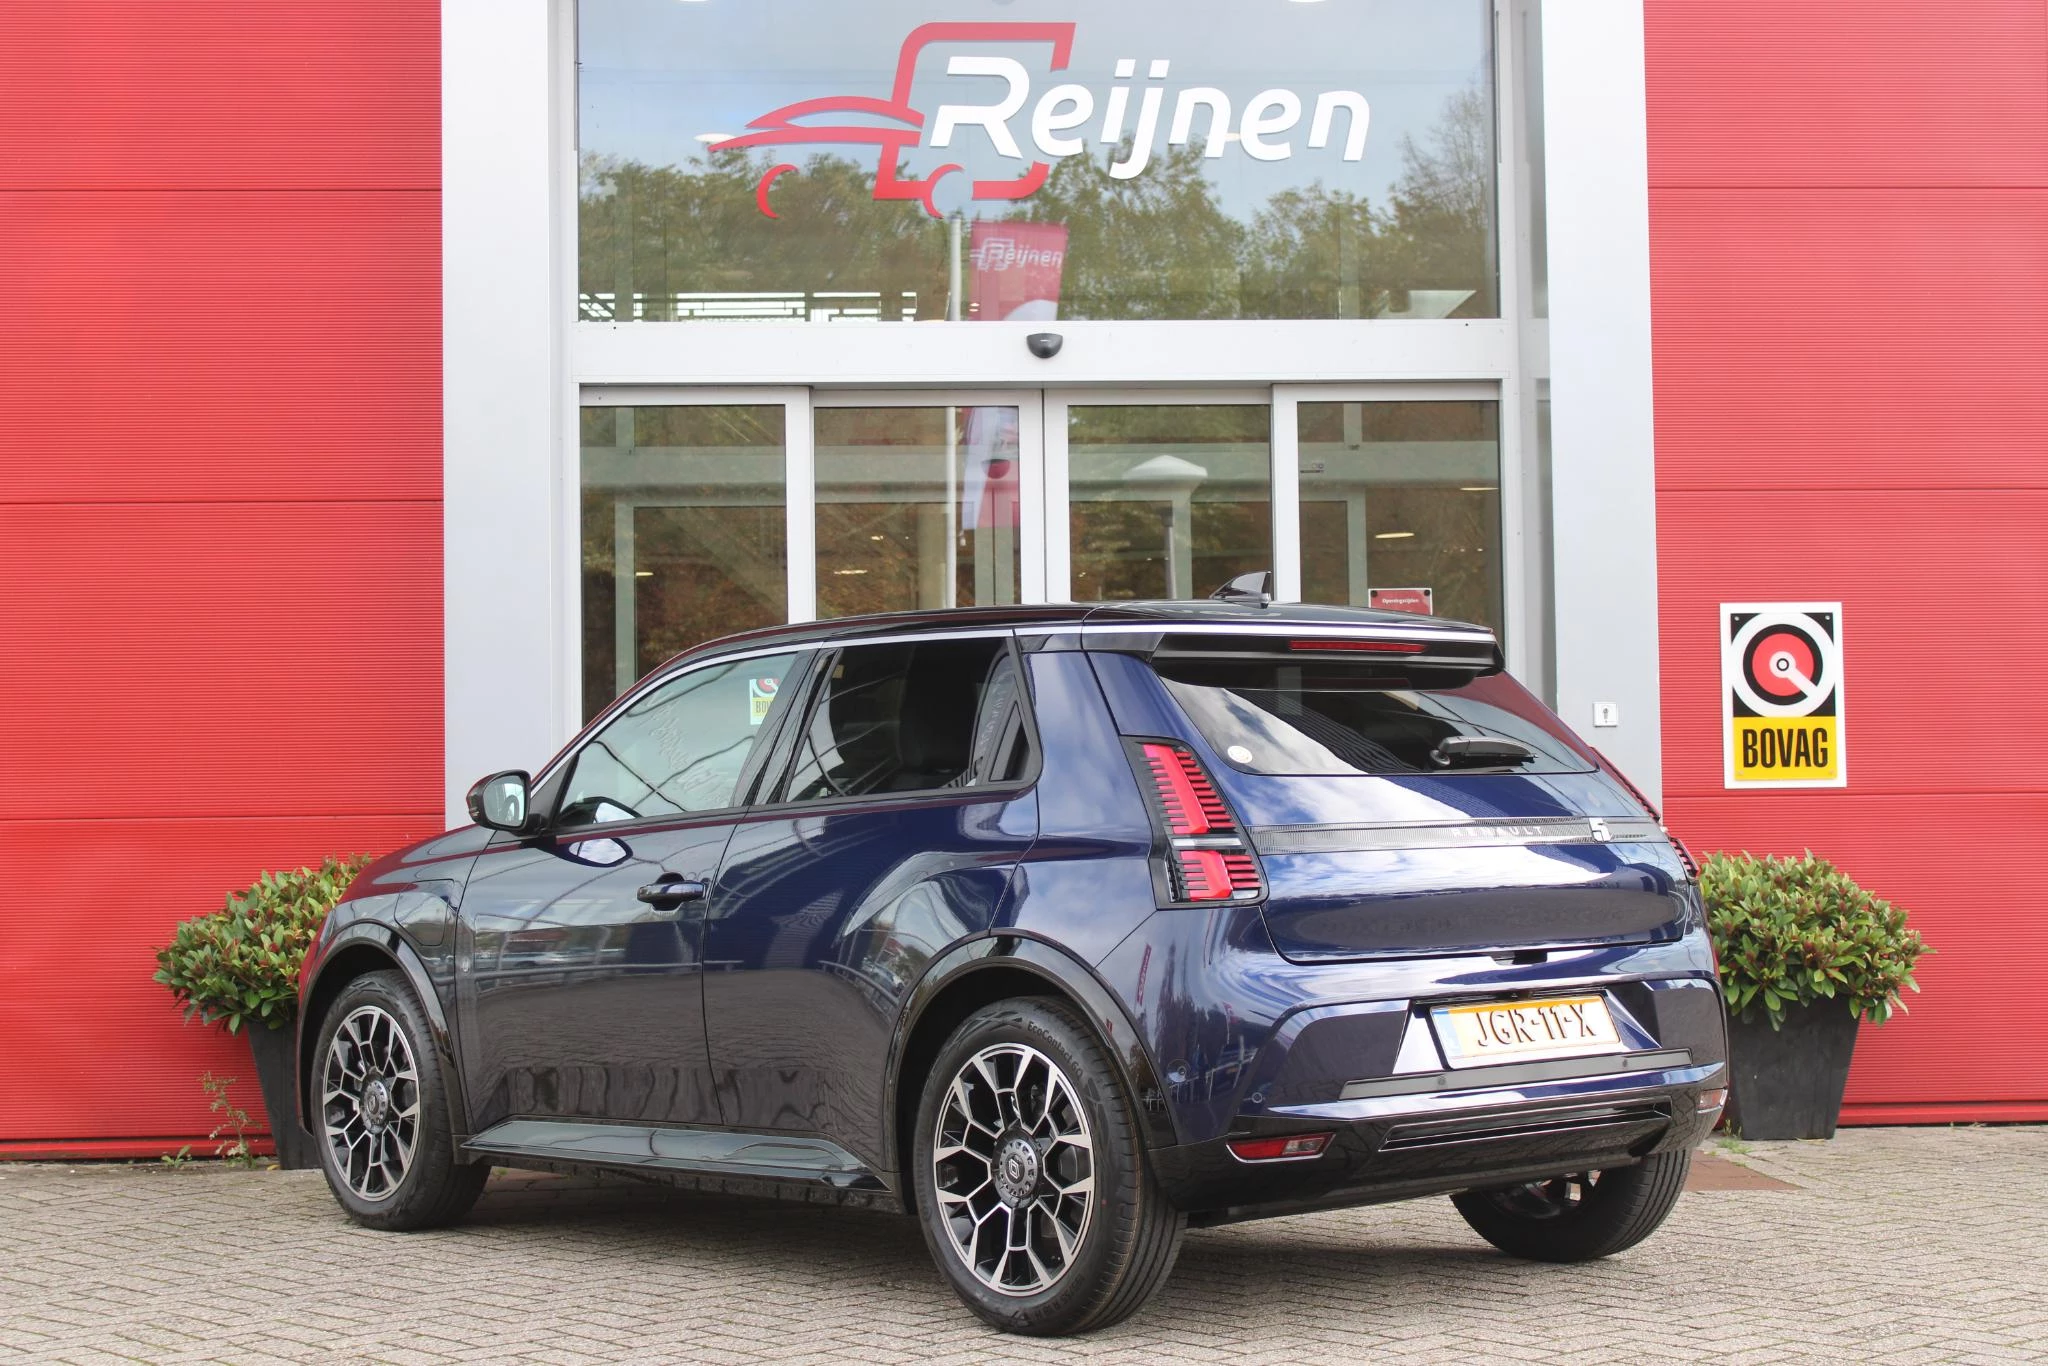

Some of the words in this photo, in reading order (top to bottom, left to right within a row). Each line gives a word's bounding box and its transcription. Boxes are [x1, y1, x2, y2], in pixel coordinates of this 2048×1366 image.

[929, 56, 1370, 180] Reijnen
[988, 242, 1064, 269] Reijnen
[1742, 727, 1829, 769] BOVAG
[1027, 1021, 1073, 1064] EcoContact
